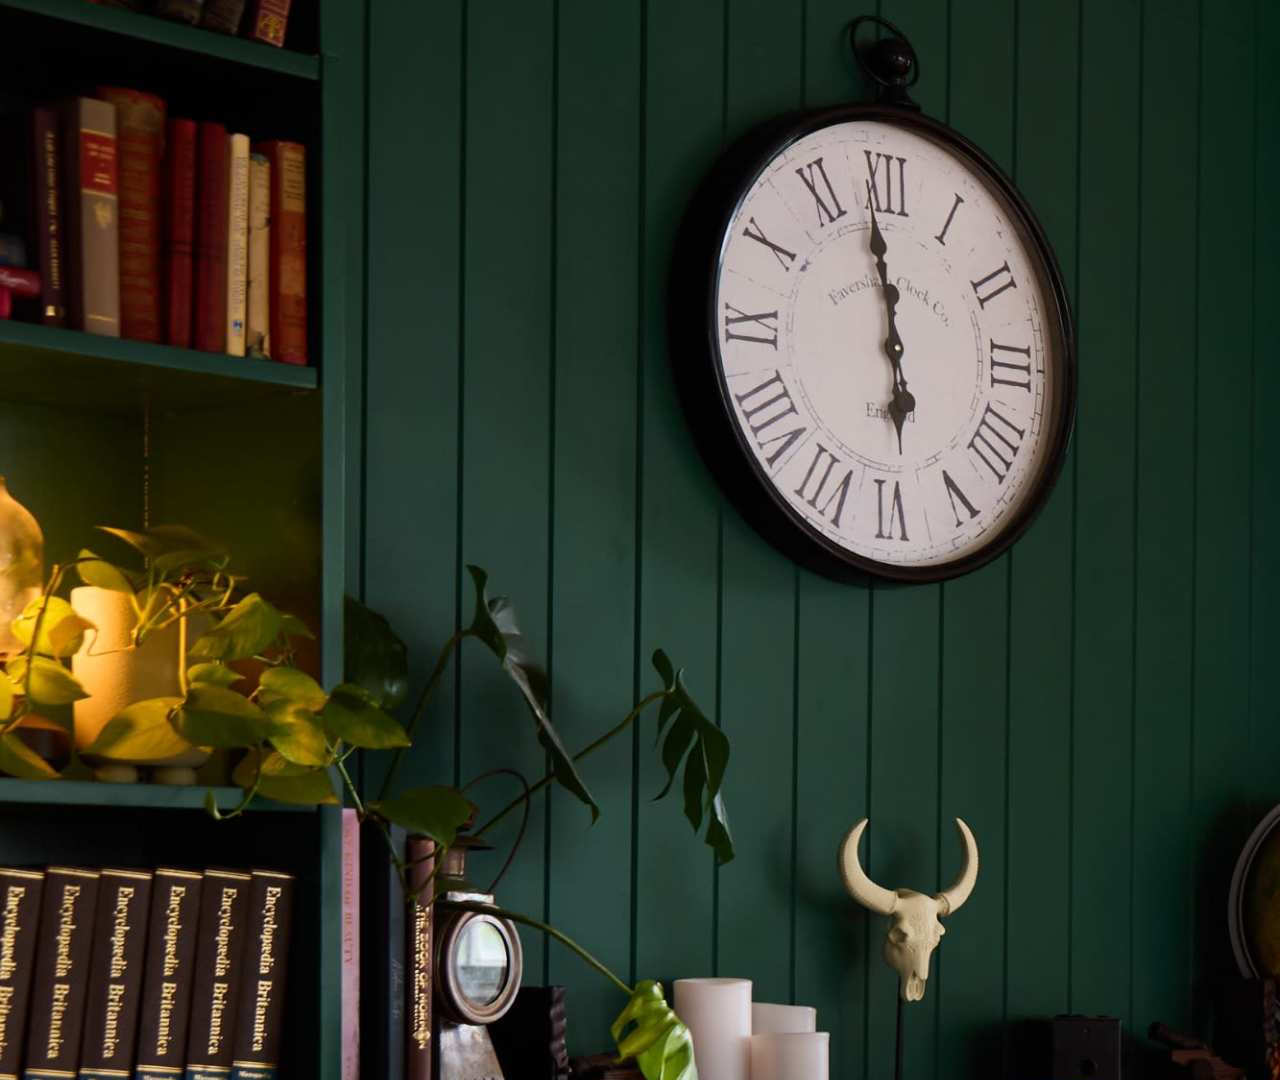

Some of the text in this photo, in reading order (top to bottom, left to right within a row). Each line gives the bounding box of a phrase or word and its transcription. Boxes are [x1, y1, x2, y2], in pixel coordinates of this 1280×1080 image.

[796, 157, 848, 228] XI
[863, 148, 911, 218] XII
[742, 216, 797, 273] X
[933, 192, 965, 247] I
[827, 272, 894, 308] Faversha
[970, 259, 1019, 311] II
[724, 302, 780, 351] IX
[989, 337, 1032, 394] III
[734, 369, 807, 469] VIII
[864, 400, 916, 424] Engd
[967, 402, 1025, 486] IIII
[794, 442, 854, 529] VII
[873, 478, 911, 542] VI
[941, 469, 982, 529] V
[418, 932, 430, 969] BOOK
[418, 972, 430, 990] OF
[46, 983, 72, 1060] Britannica
[101, 983, 127, 1060] Britannica
[155, 981, 178, 1057] Britannica
[206, 981, 230, 1057] Britannica
[251, 979, 274, 1053] Britannica
